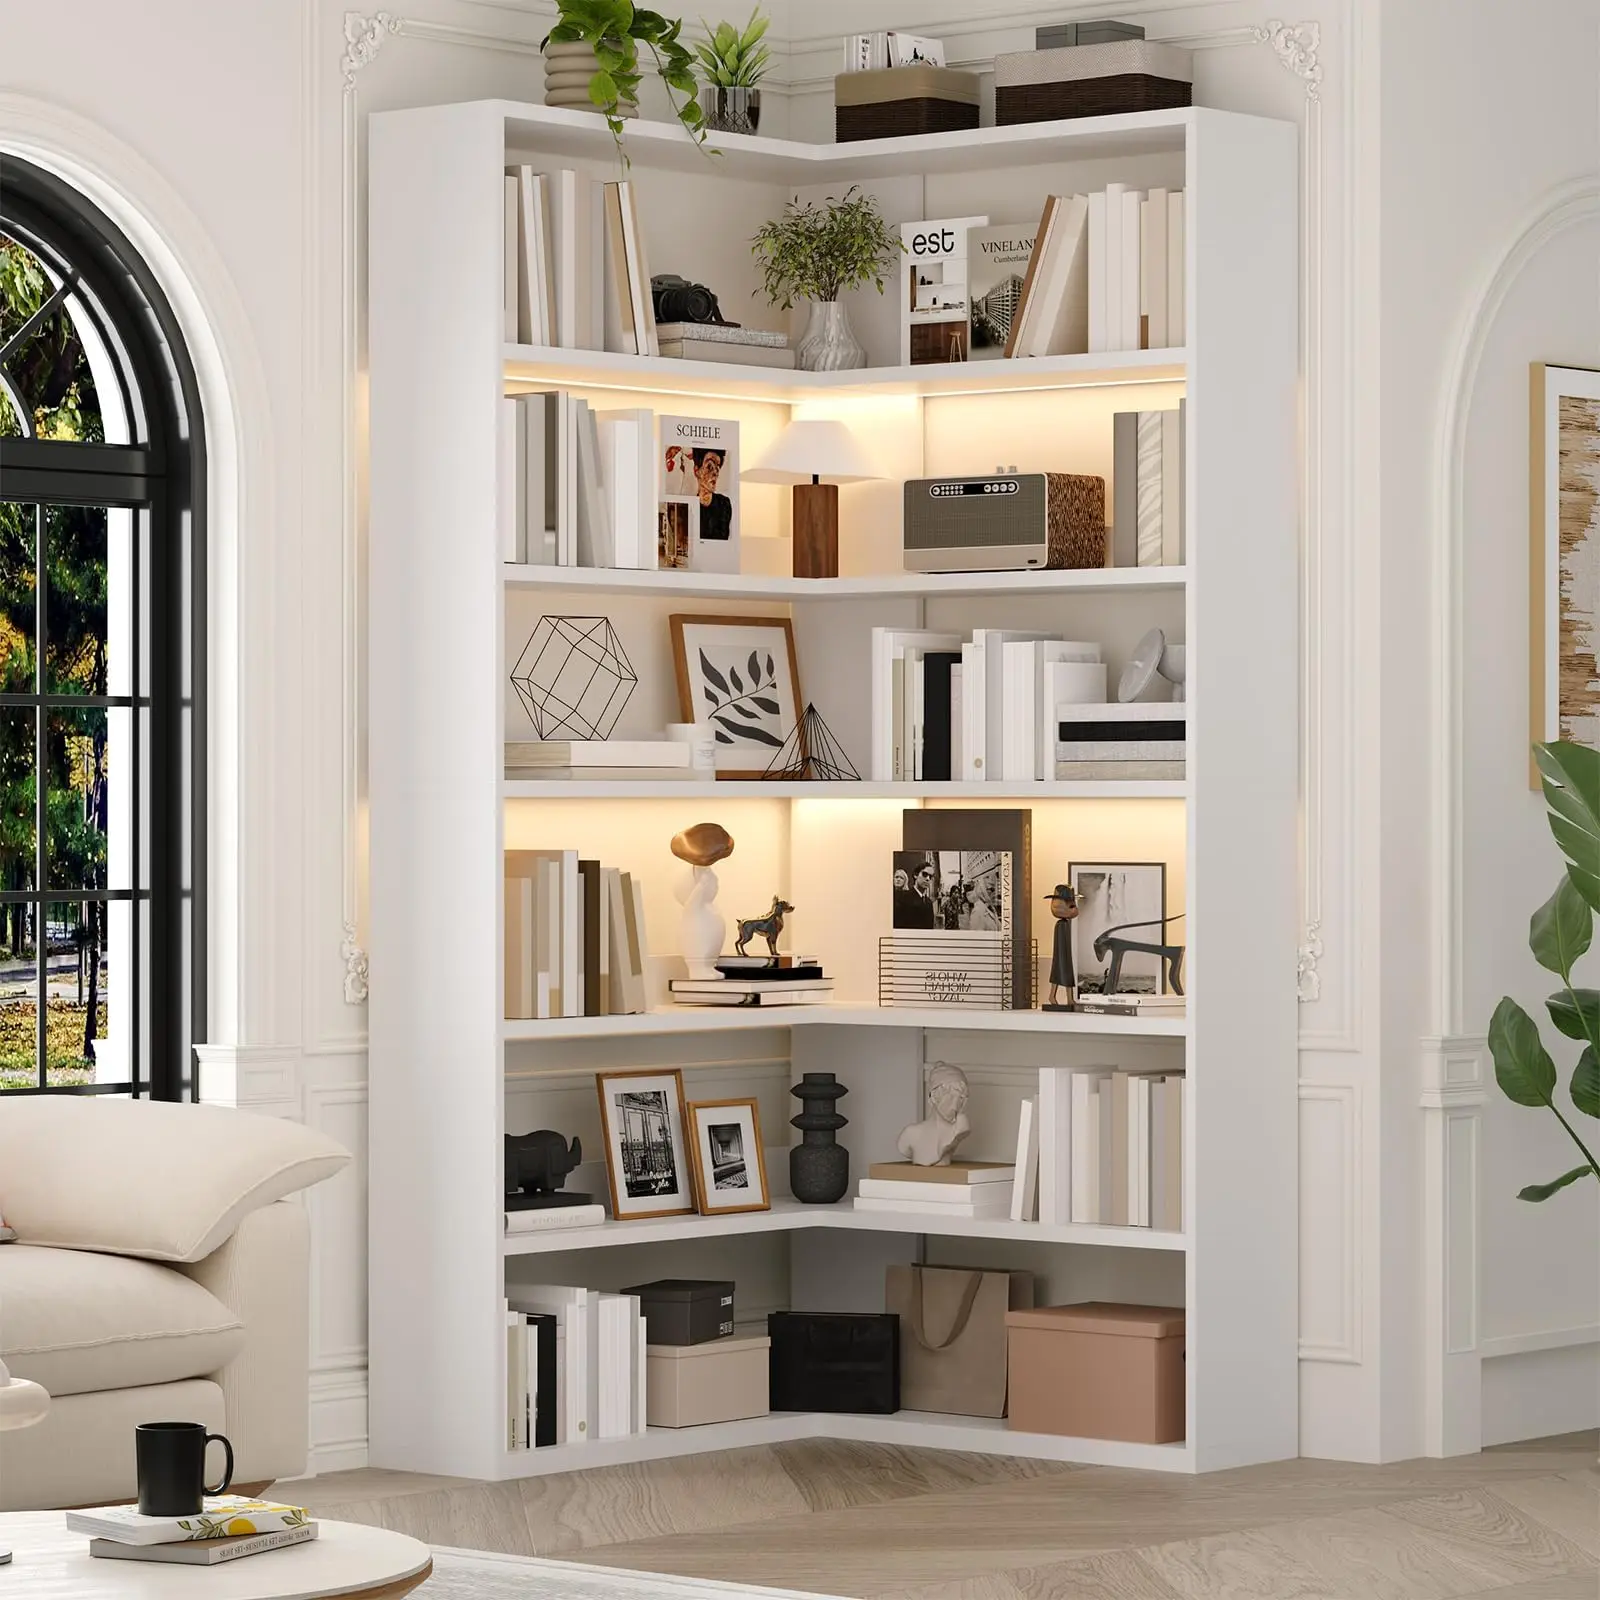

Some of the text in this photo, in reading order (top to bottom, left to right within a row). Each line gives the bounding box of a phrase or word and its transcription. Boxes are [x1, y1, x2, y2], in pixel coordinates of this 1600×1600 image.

[912, 228, 954, 255] est
[993, 255, 1029, 263] Cumberland
[676, 424, 720, 439] SCHIELE
